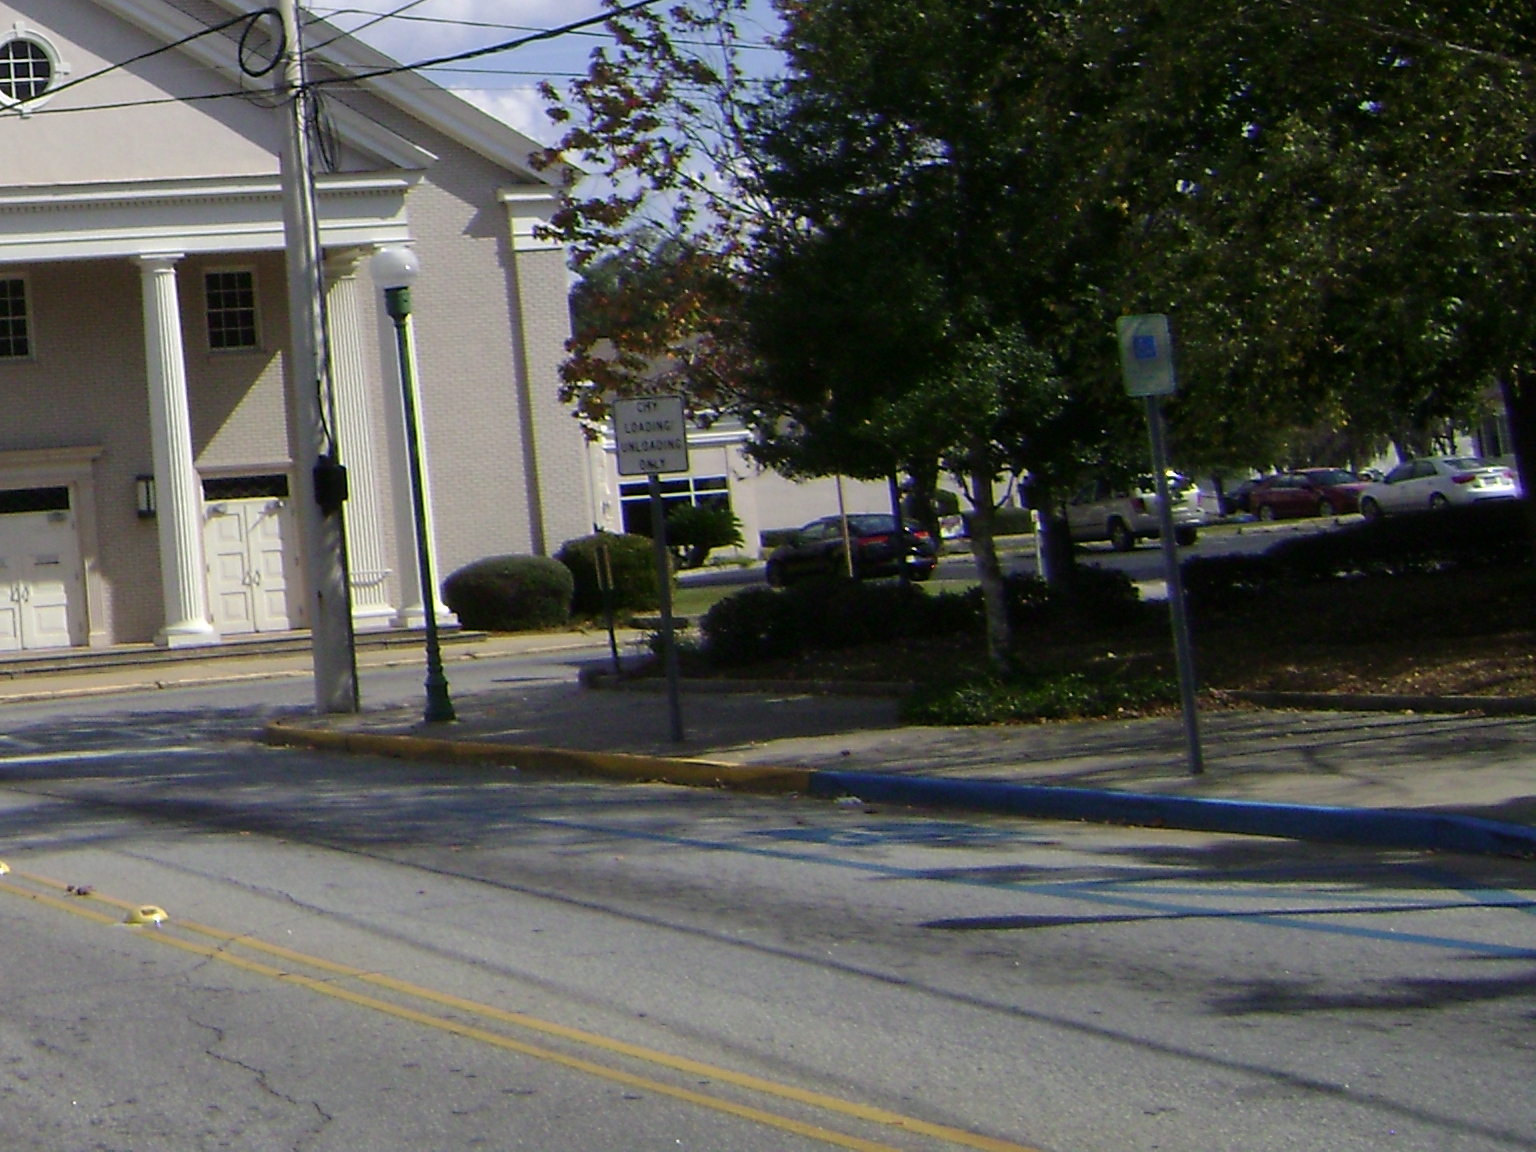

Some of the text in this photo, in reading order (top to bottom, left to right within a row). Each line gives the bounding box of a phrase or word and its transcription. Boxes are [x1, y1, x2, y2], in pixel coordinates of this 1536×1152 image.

[625, 420, 670, 434] LOADING
[620, 438, 681, 453] UNLOADING
[639, 458, 665, 470] ONLY
